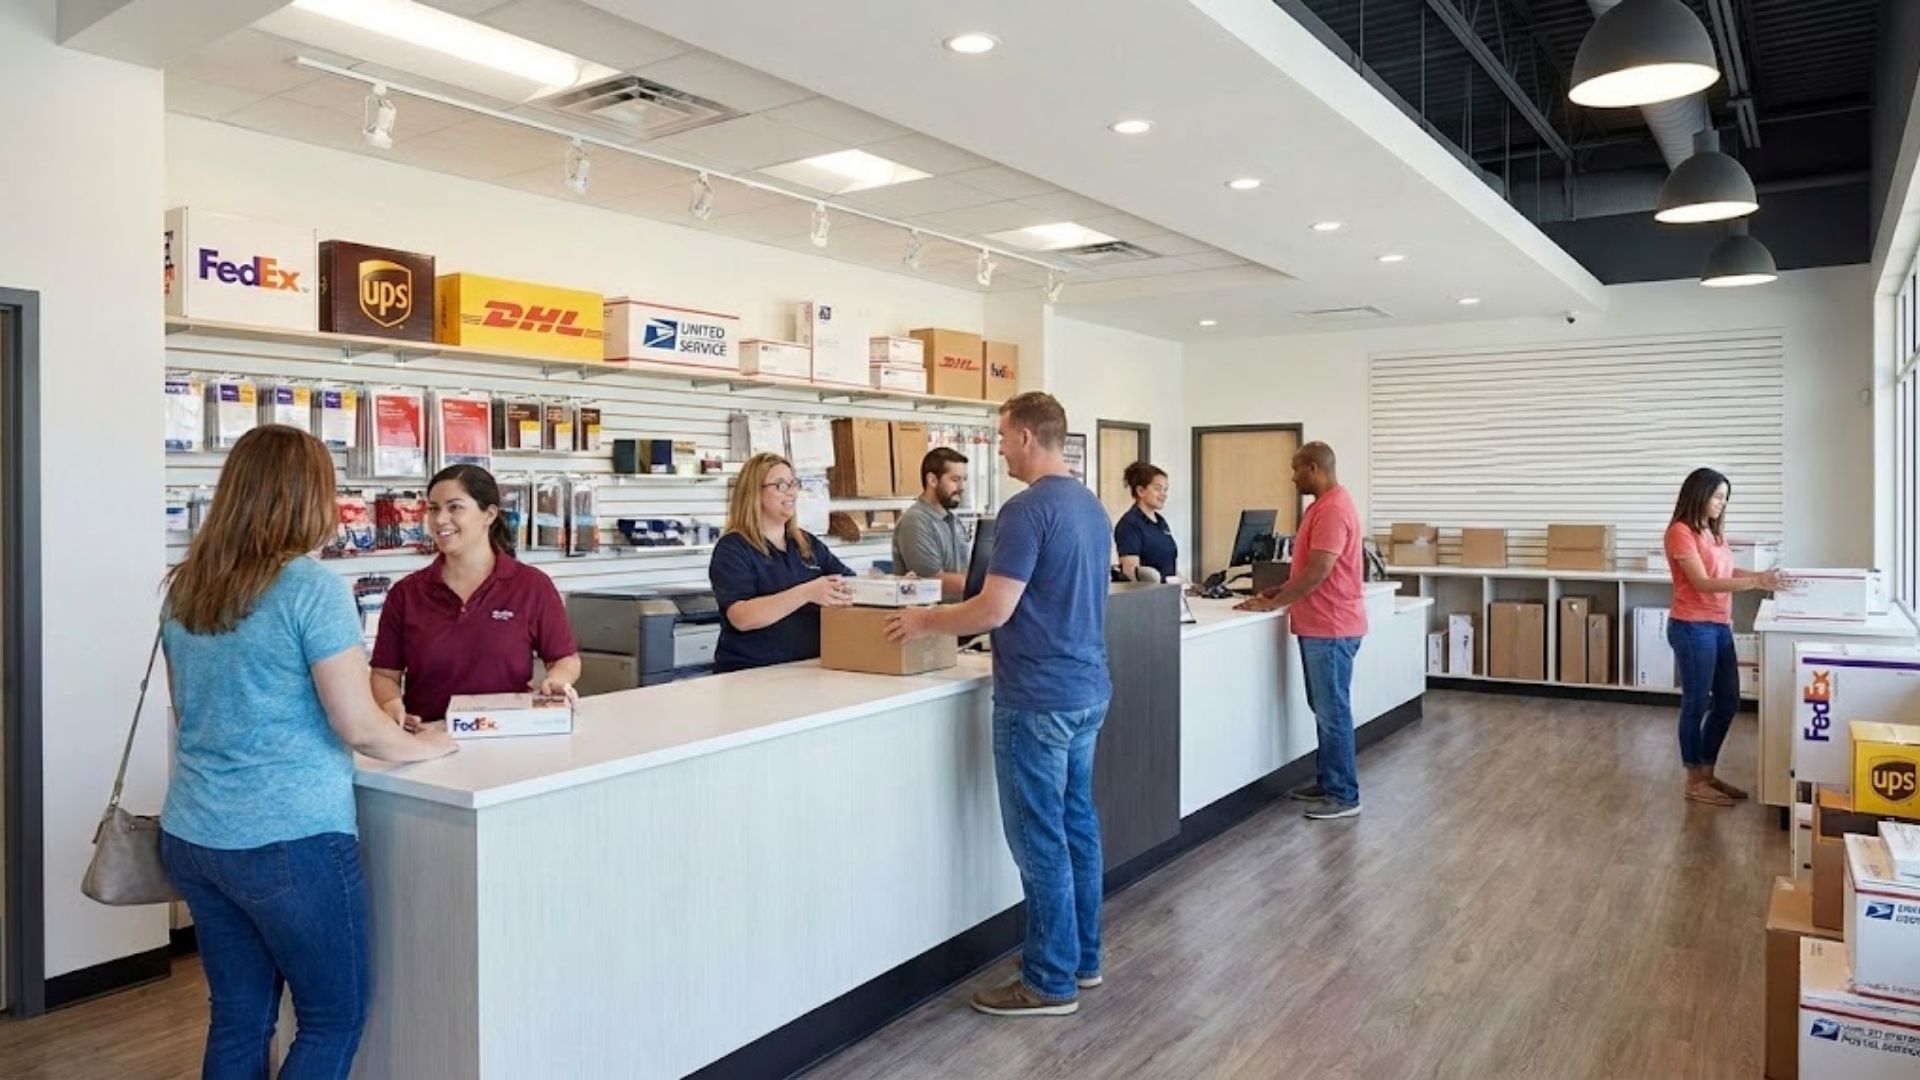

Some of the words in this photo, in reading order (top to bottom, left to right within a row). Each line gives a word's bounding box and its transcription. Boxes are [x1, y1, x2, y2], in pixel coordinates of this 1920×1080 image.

[199, 247, 300, 292] FedEx
[364, 279, 408, 316] ups
[482, 300, 584, 337] DHL
[680, 322, 725, 339] UNITED
[679, 340, 727, 357] SERVICE
[1803, 670, 1830, 742] FedEx
[1873, 770, 1915, 796] ups
